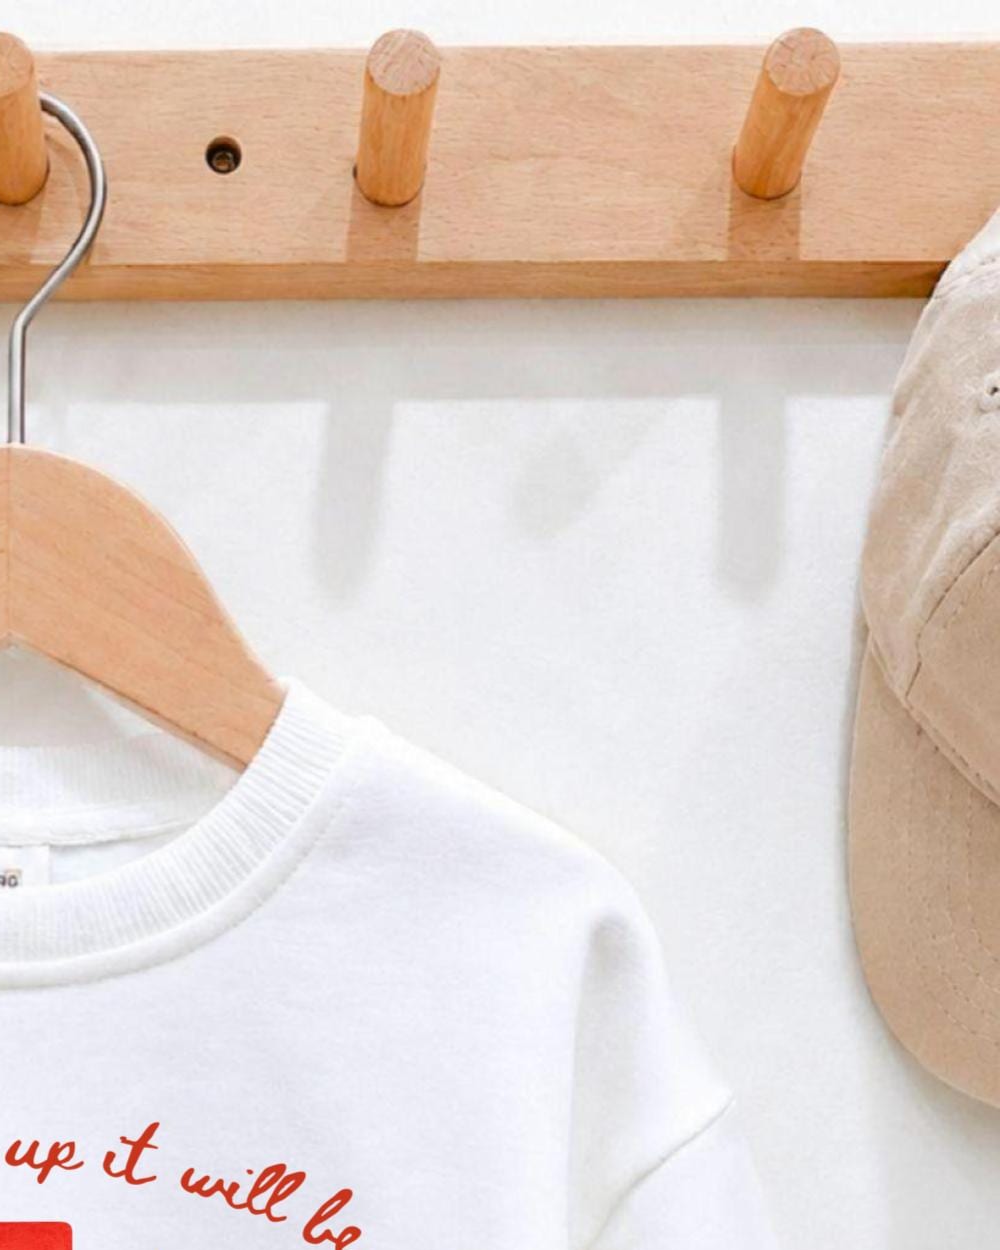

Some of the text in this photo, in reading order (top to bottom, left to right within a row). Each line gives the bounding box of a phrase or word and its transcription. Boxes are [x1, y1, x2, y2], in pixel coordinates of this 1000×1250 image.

[4, 1140, 83, 1185] up
[103, 1121, 160, 1185] it
[180, 1162, 307, 1223] will
